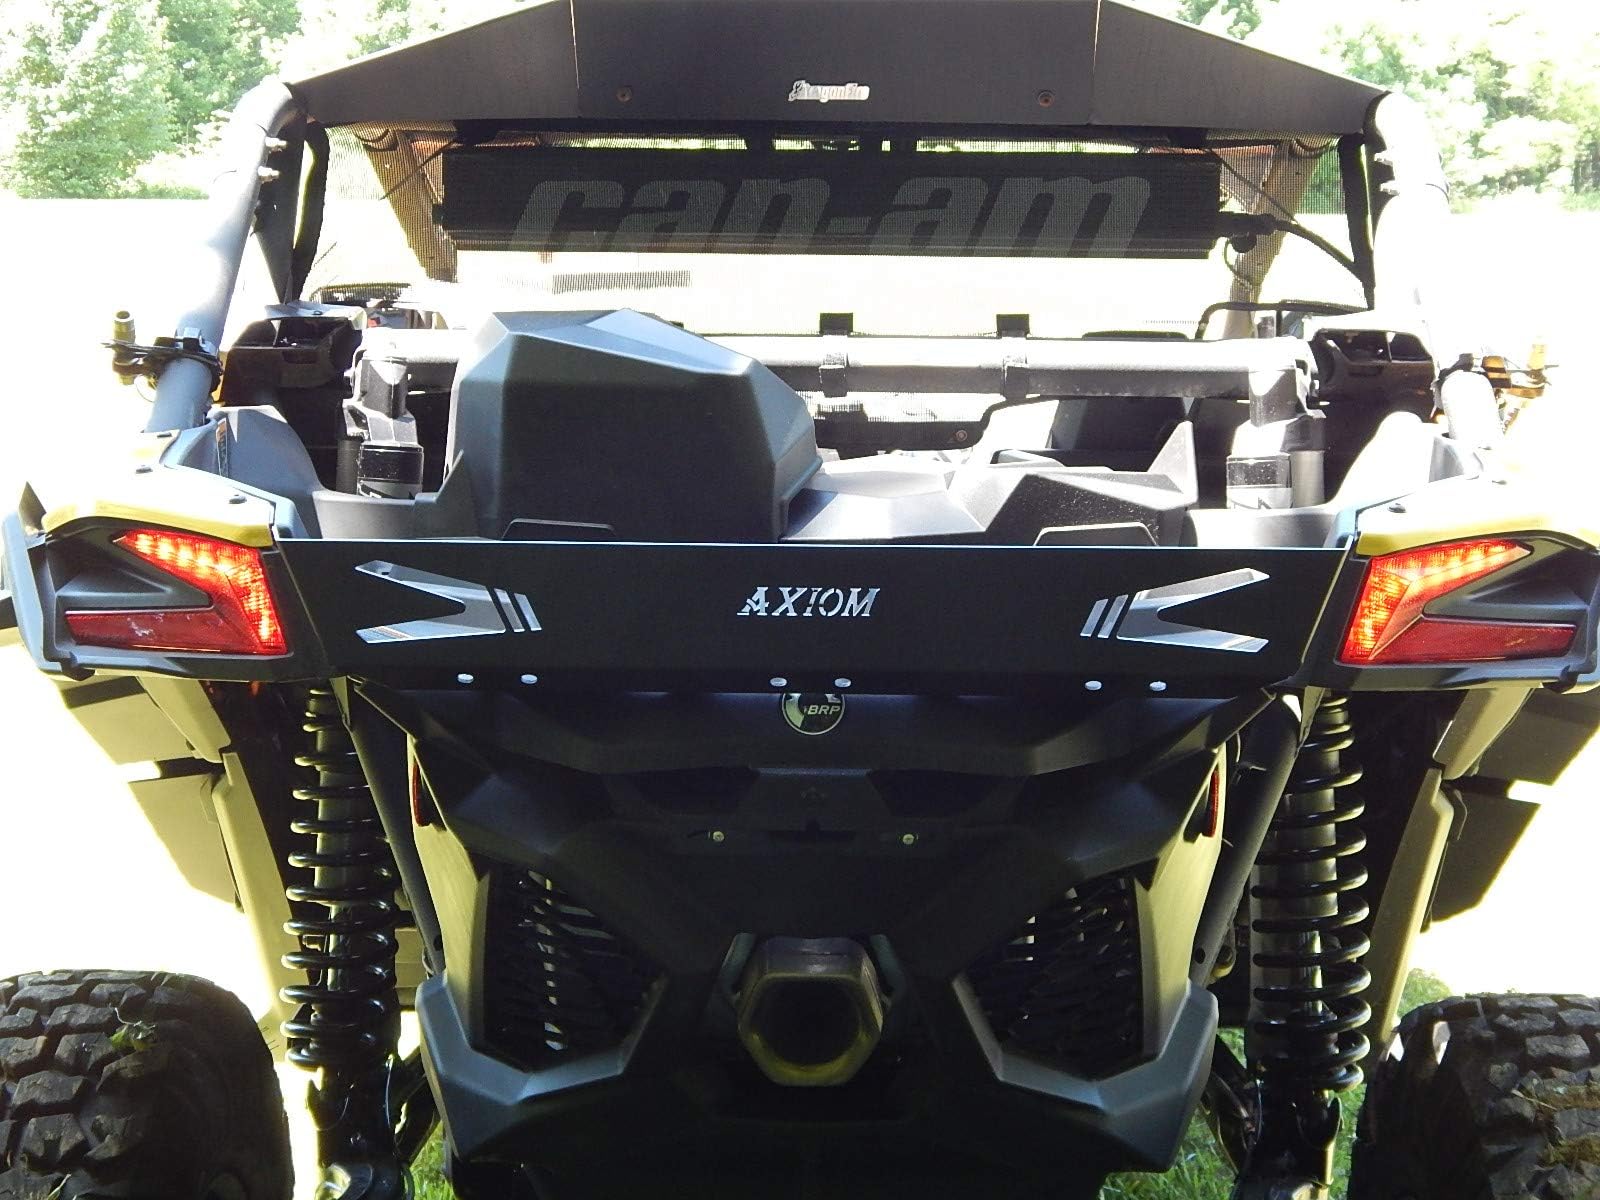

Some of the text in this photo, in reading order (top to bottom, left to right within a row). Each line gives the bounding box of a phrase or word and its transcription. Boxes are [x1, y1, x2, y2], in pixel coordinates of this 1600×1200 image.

[510, 176, 1151, 258] can-am
[736, 586, 881, 617] AXIOM
[807, 704, 842, 716] BRP
